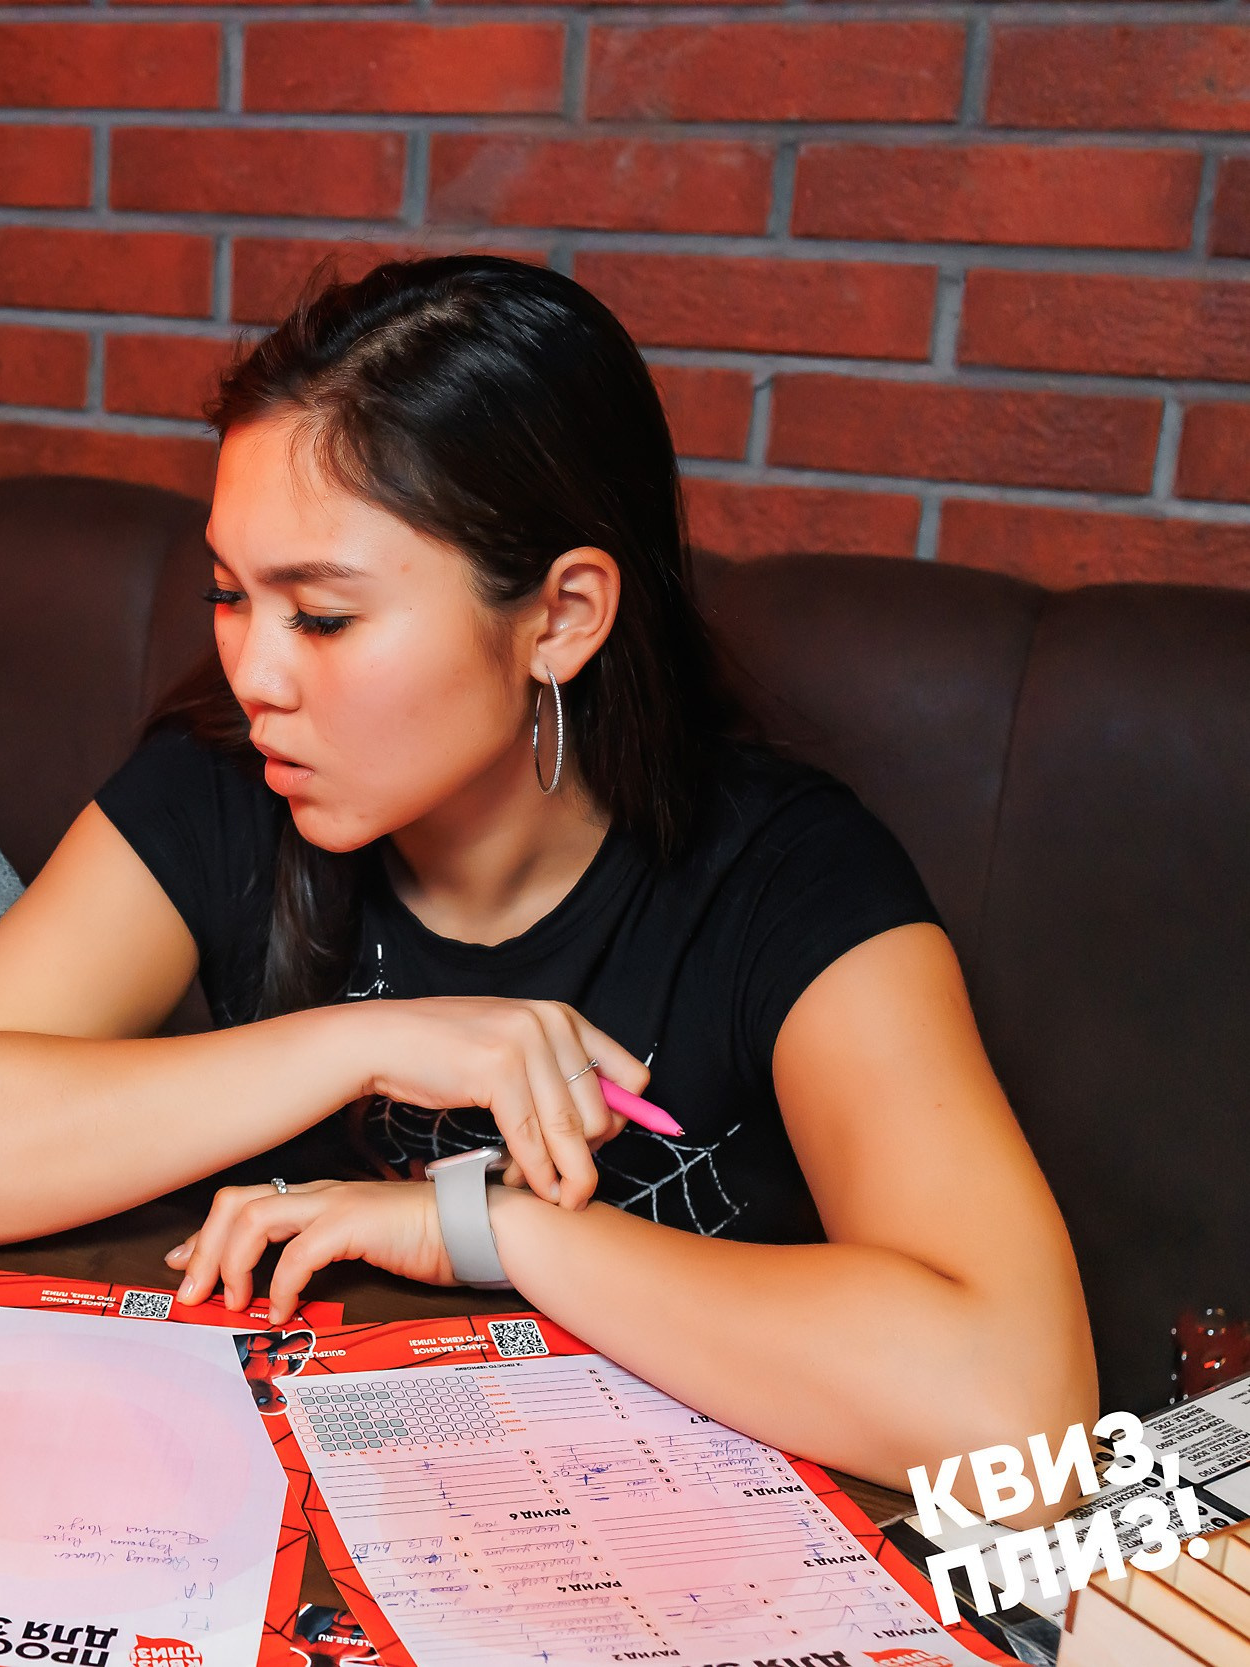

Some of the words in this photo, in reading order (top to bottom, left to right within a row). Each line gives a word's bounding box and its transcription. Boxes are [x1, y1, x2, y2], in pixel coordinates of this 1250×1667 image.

[41, 1288, 68, 1297] ПЛИЗ!
[69, 1291, 95, 1299] КВИЗ,
[40, 1295, 79, 1304] ВАЖНОЕ
[80, 1299, 114, 1308] САМОЕ
[437, 1335, 464, 1344] КВИЗ,
[412, 1345, 454, 1354] ВАЖНОЕ
[454, 1342, 488, 1350] САМОЕ
[689, 1416, 697, 1424] 7
[742, 1489, 752, 1497] 5
[752, 1483, 803, 1496] РАУНД
[509, 1512, 518, 1520] 6
[519, 1506, 570, 1519] РАУНД
[802, 1559, 813, 1567] 3
[816, 1551, 867, 1566] РАУНД
[568, 1579, 622, 1592] РАУНД
[22, 1621, 118, 1649] ДЛЯ
[883, 1624, 937, 1638] РАУНД
[623, 1647, 680, 1661] РАУНД
